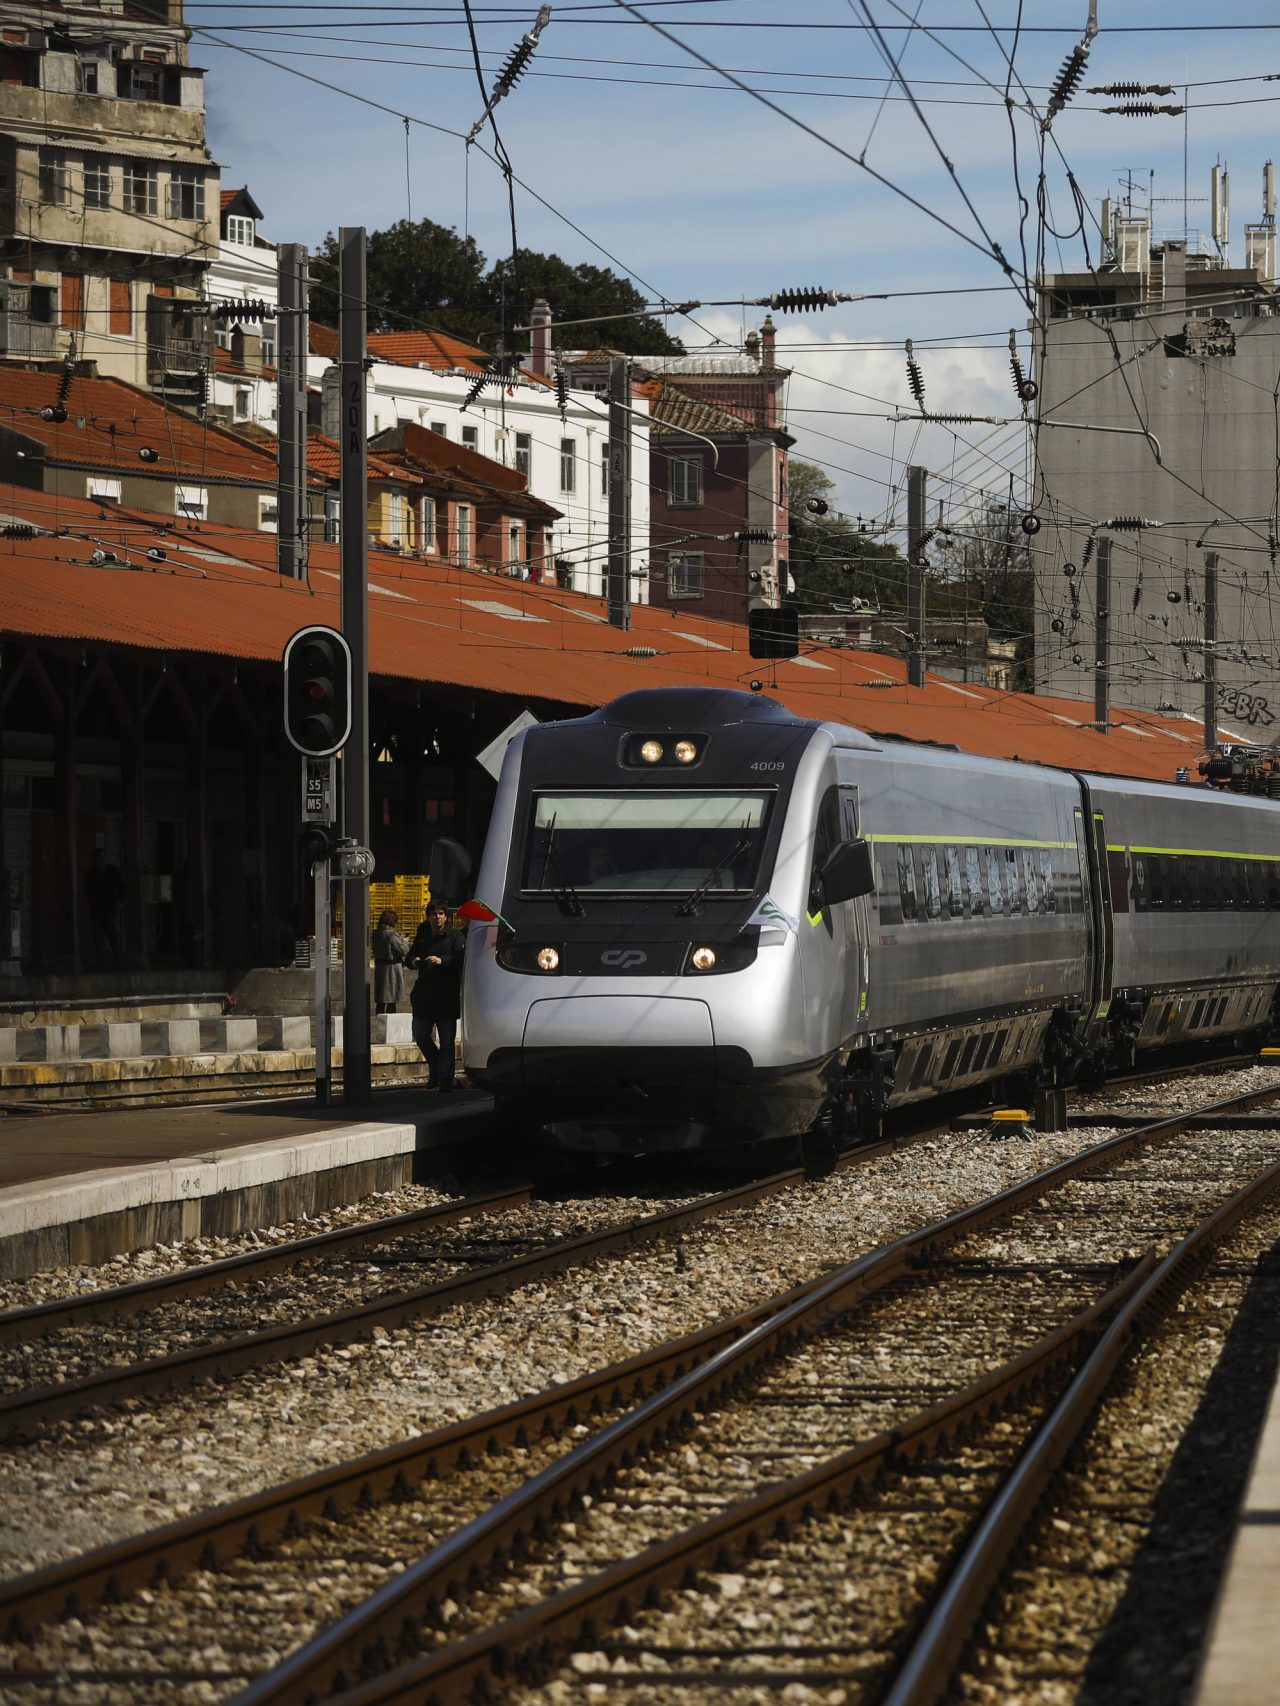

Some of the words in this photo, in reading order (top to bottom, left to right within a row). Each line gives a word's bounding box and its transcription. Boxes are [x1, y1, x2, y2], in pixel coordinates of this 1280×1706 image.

[348, 380, 361, 454] 20A
[750, 761, 785, 771] 4009
[308, 779, 321, 791] S5
[307, 798, 322, 810] M5
[600, 949, 648, 969] CP
